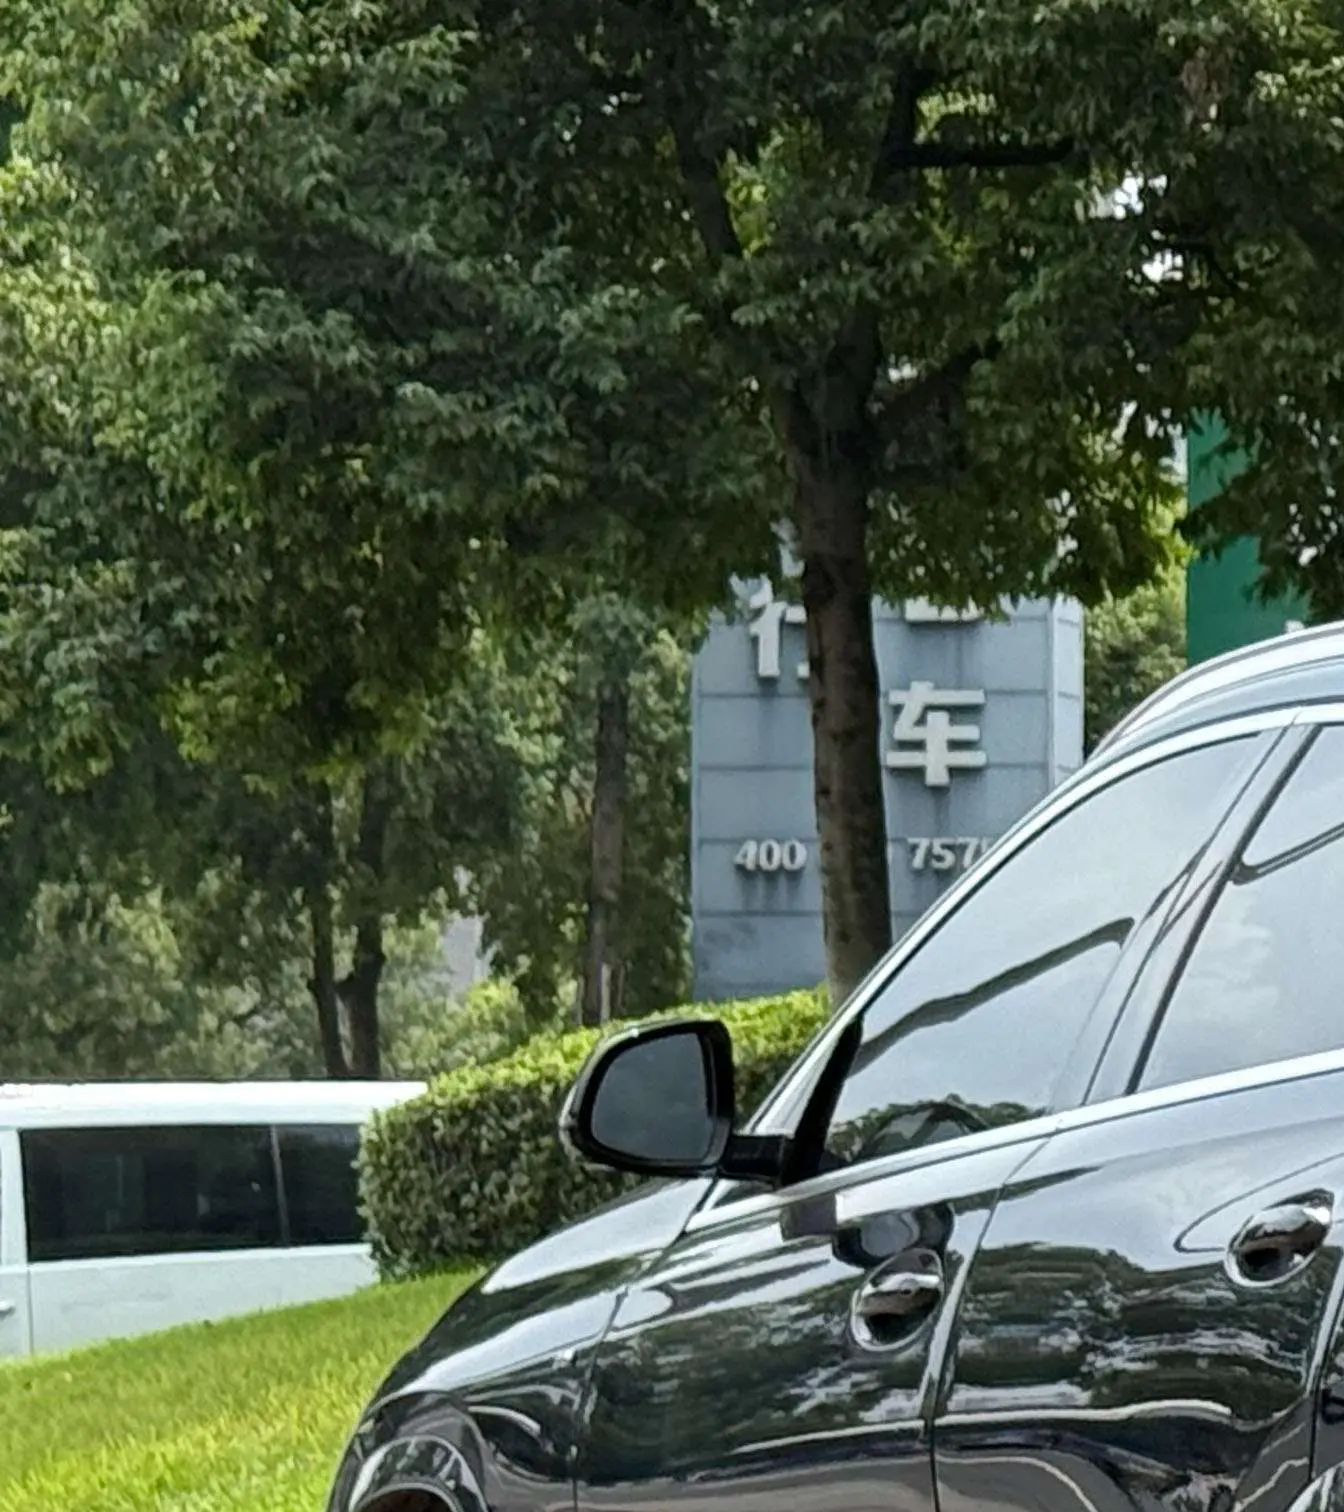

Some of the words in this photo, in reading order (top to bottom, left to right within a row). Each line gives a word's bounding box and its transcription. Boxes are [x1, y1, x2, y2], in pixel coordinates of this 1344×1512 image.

[886, 681, 987, 787] 车
[735, 839, 807, 873] 400
[907, 836, 997, 870] 757
